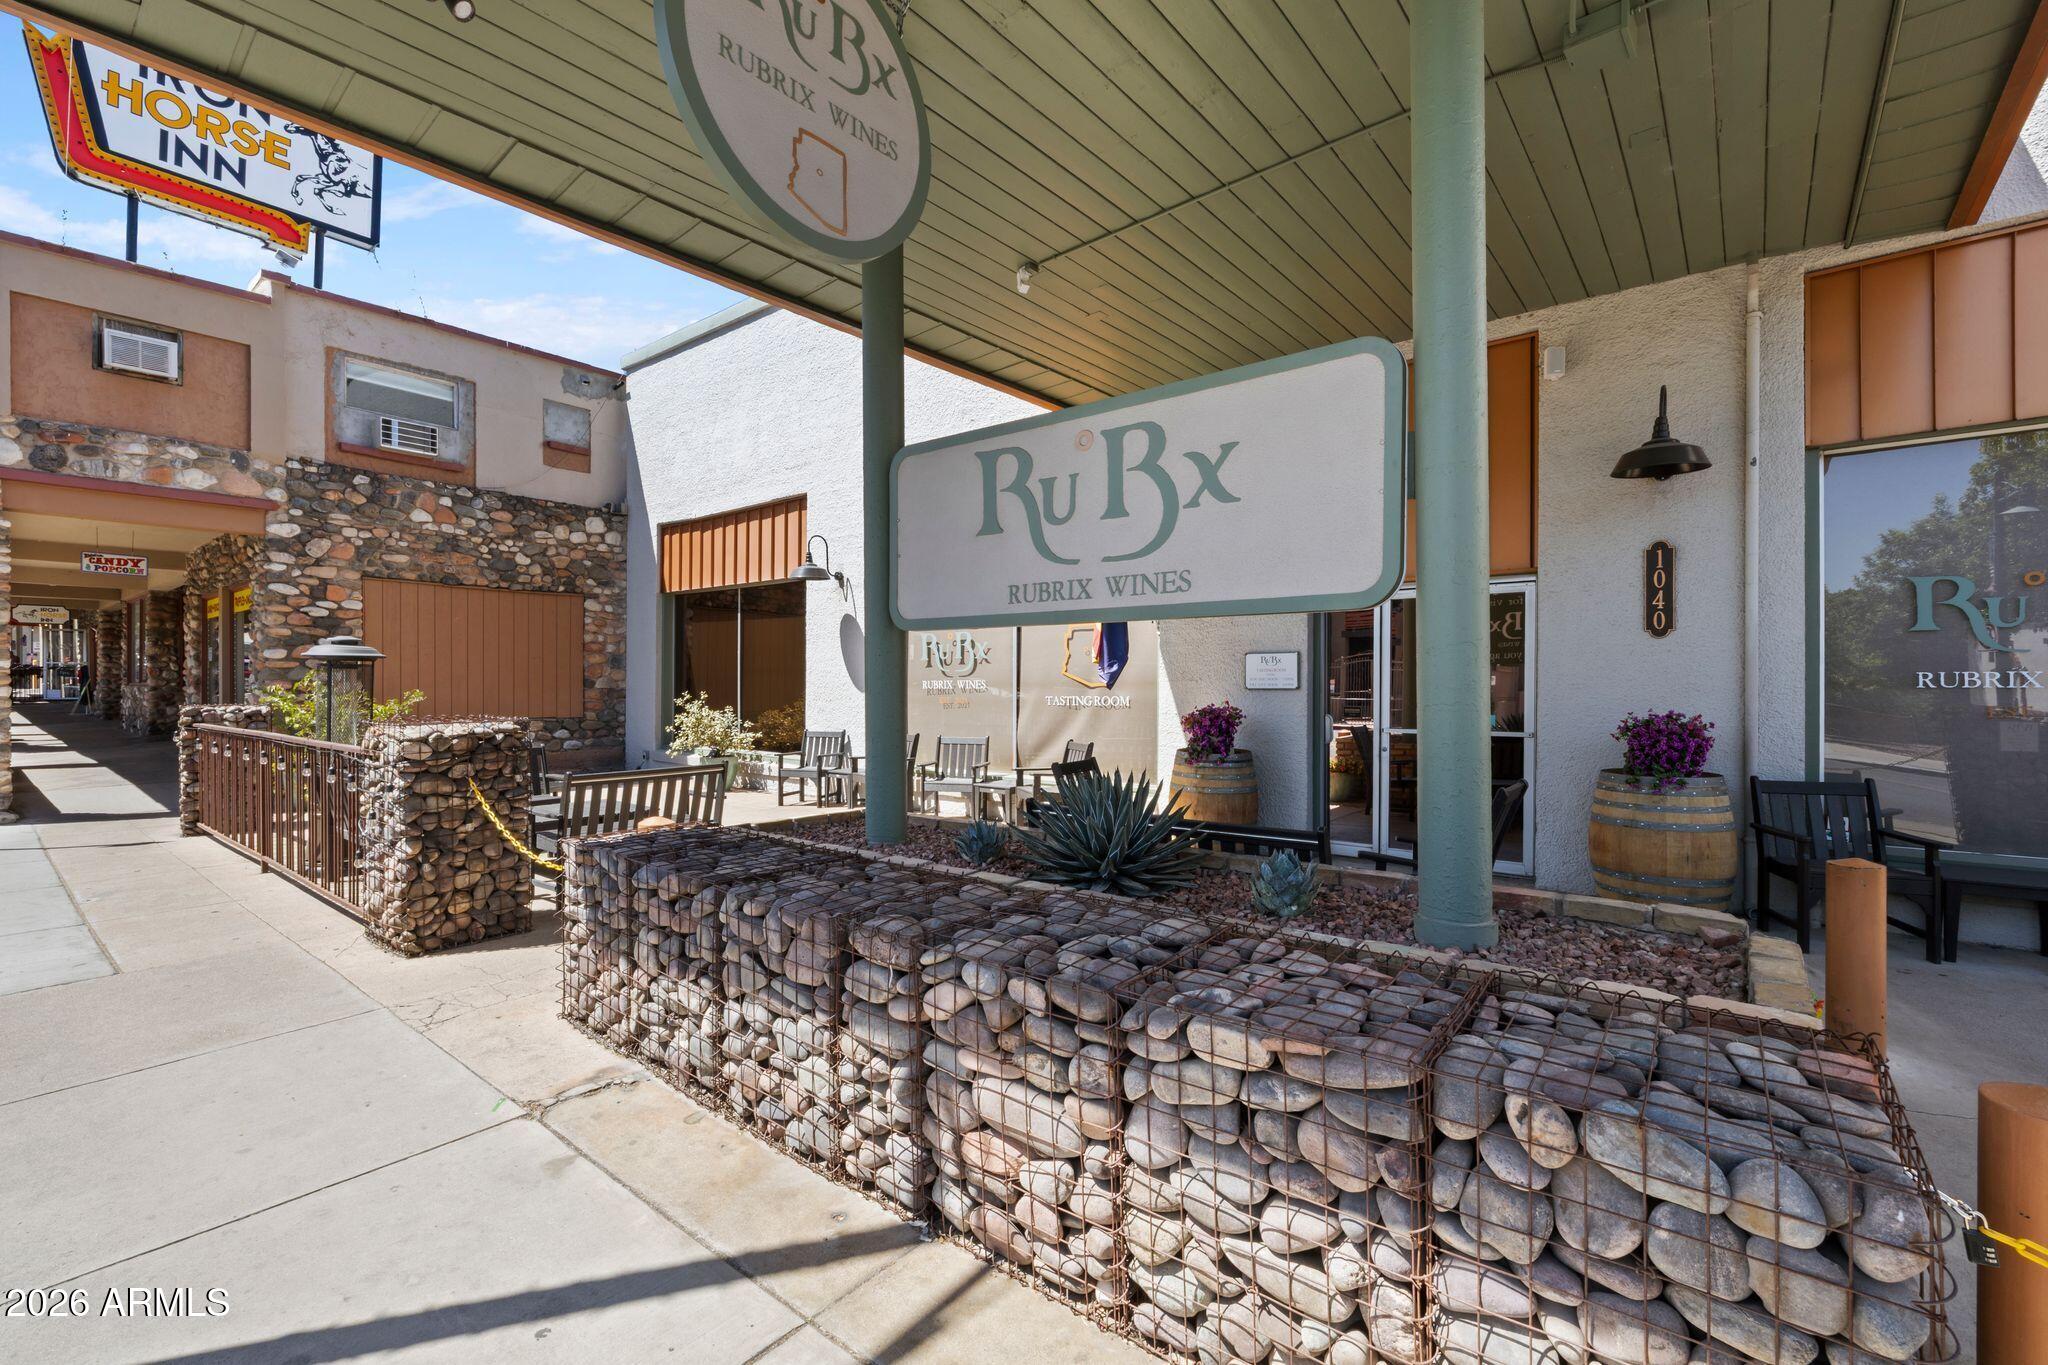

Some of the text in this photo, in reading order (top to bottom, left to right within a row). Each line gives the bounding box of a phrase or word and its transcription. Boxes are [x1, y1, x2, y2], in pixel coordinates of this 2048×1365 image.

[717, 32, 898, 161] RUBRIX WINES
[101, 69, 292, 171] HORSE
[158, 129, 247, 189] INN
[89, 557, 146, 567] CANDY
[94, 564, 145, 574] POPCORN
[1007, 569, 1193, 606] RUBRIX WINES
[1652, 547, 1666, 630] 1040
[922, 679, 987, 690] RUBRIX WINES
[1916, 670, 2044, 689] RUBRIX
